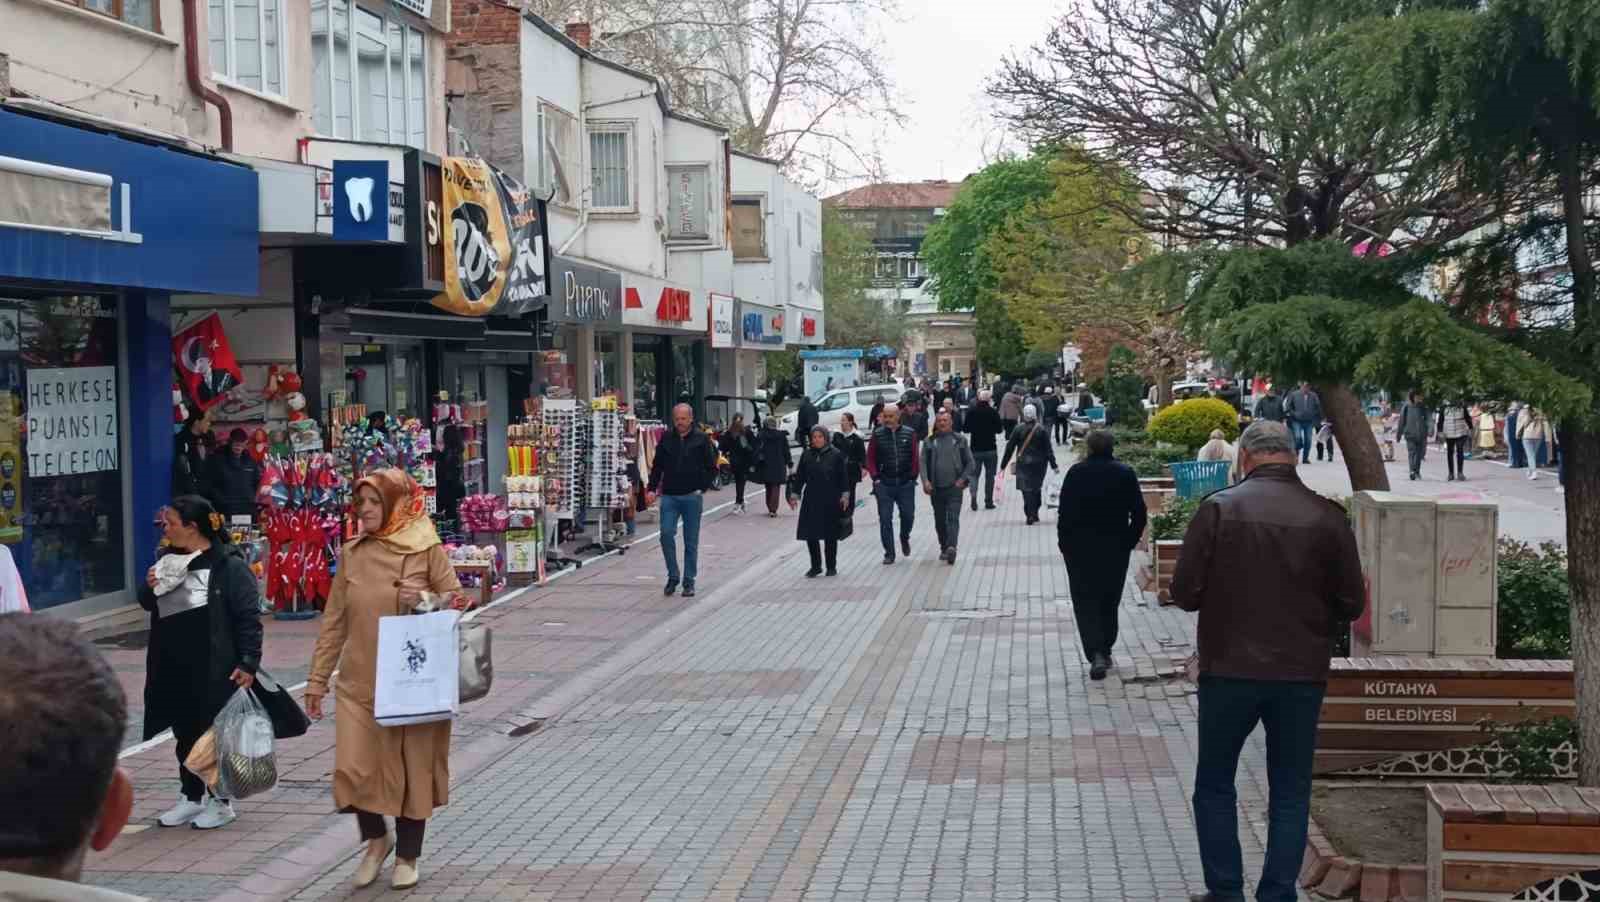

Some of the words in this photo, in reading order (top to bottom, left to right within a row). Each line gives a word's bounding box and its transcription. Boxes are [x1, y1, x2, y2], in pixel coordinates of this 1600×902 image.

[29, 378, 113, 408] HERKESE
[29, 448, 117, 476] TELEFON
[1364, 680, 1437, 695] KÜTAHYA
[1365, 706, 1457, 721] BELEDİYESİ
